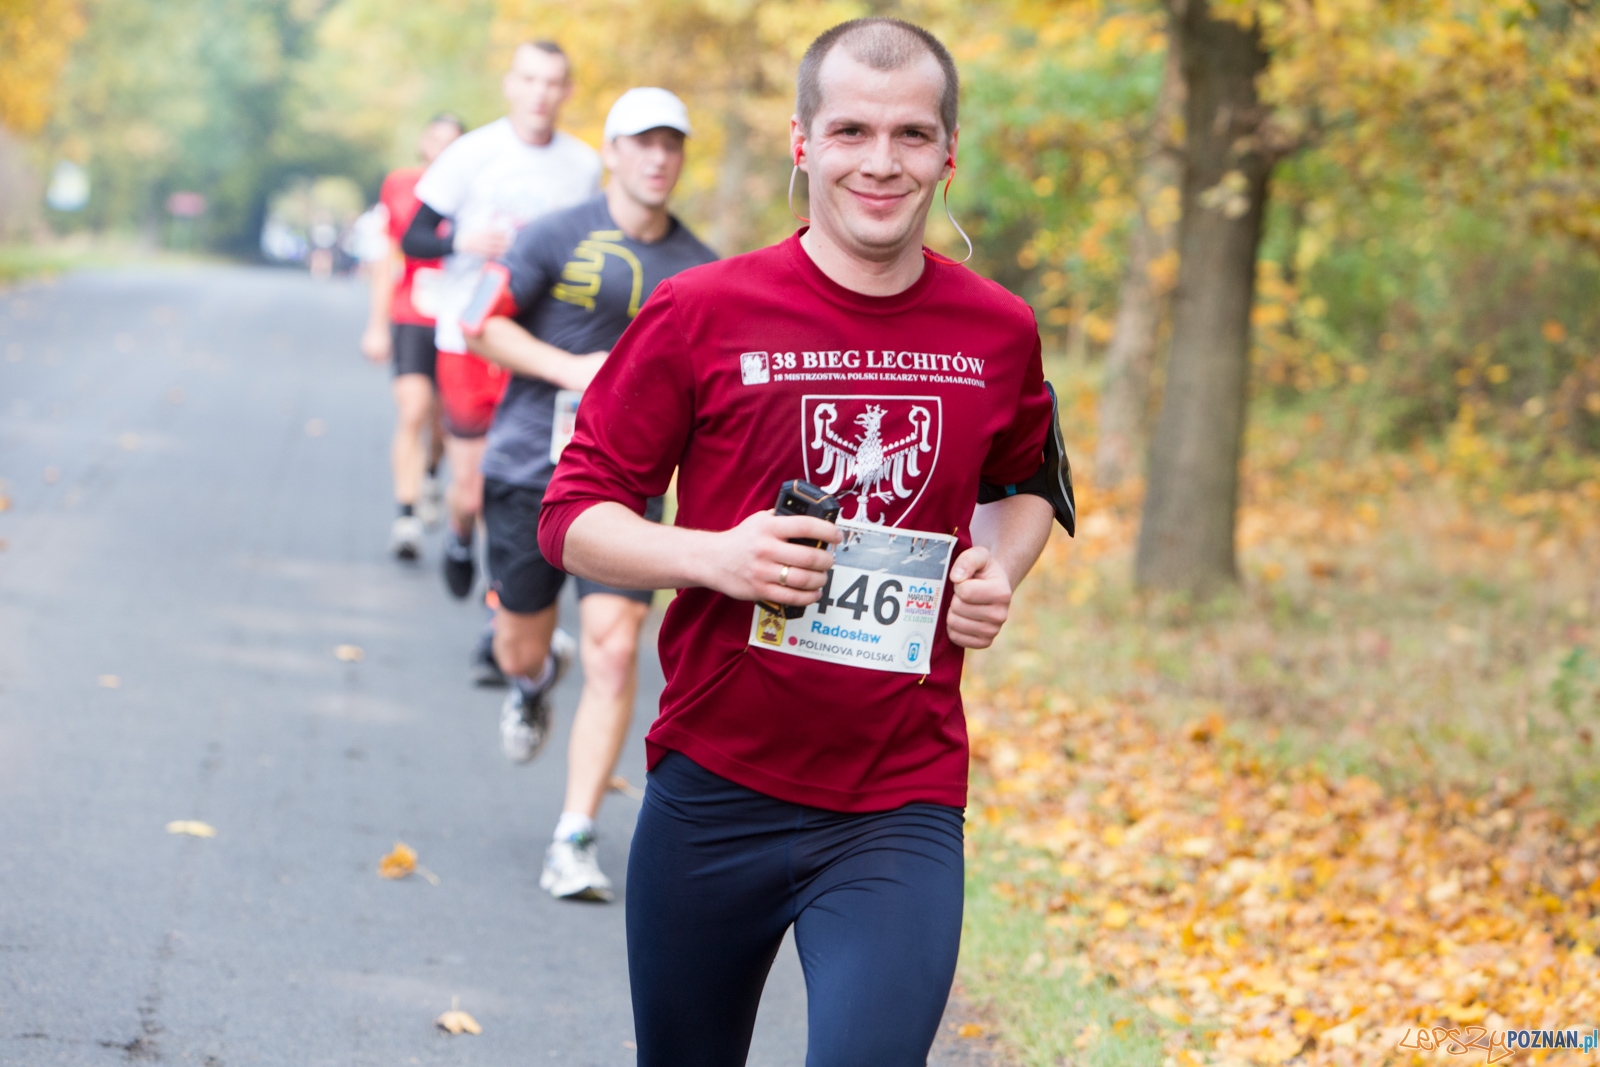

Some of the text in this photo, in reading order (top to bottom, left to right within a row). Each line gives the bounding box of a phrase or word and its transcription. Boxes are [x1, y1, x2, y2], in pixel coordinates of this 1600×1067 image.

[772, 350, 985, 375] 38 BIEG LECHITÓW
[784, 373, 846, 381] MISTRZOSTWA
[847, 373, 878, 381] POLSKI
[880, 373, 918, 382] LEKARZY
[920, 374, 928, 382] W
[907, 593, 934, 602] MARATON
[811, 620, 881, 644] Radosław
[799, 639, 853, 657] POLINOVA
[856, 649, 894, 663] POLSKA
